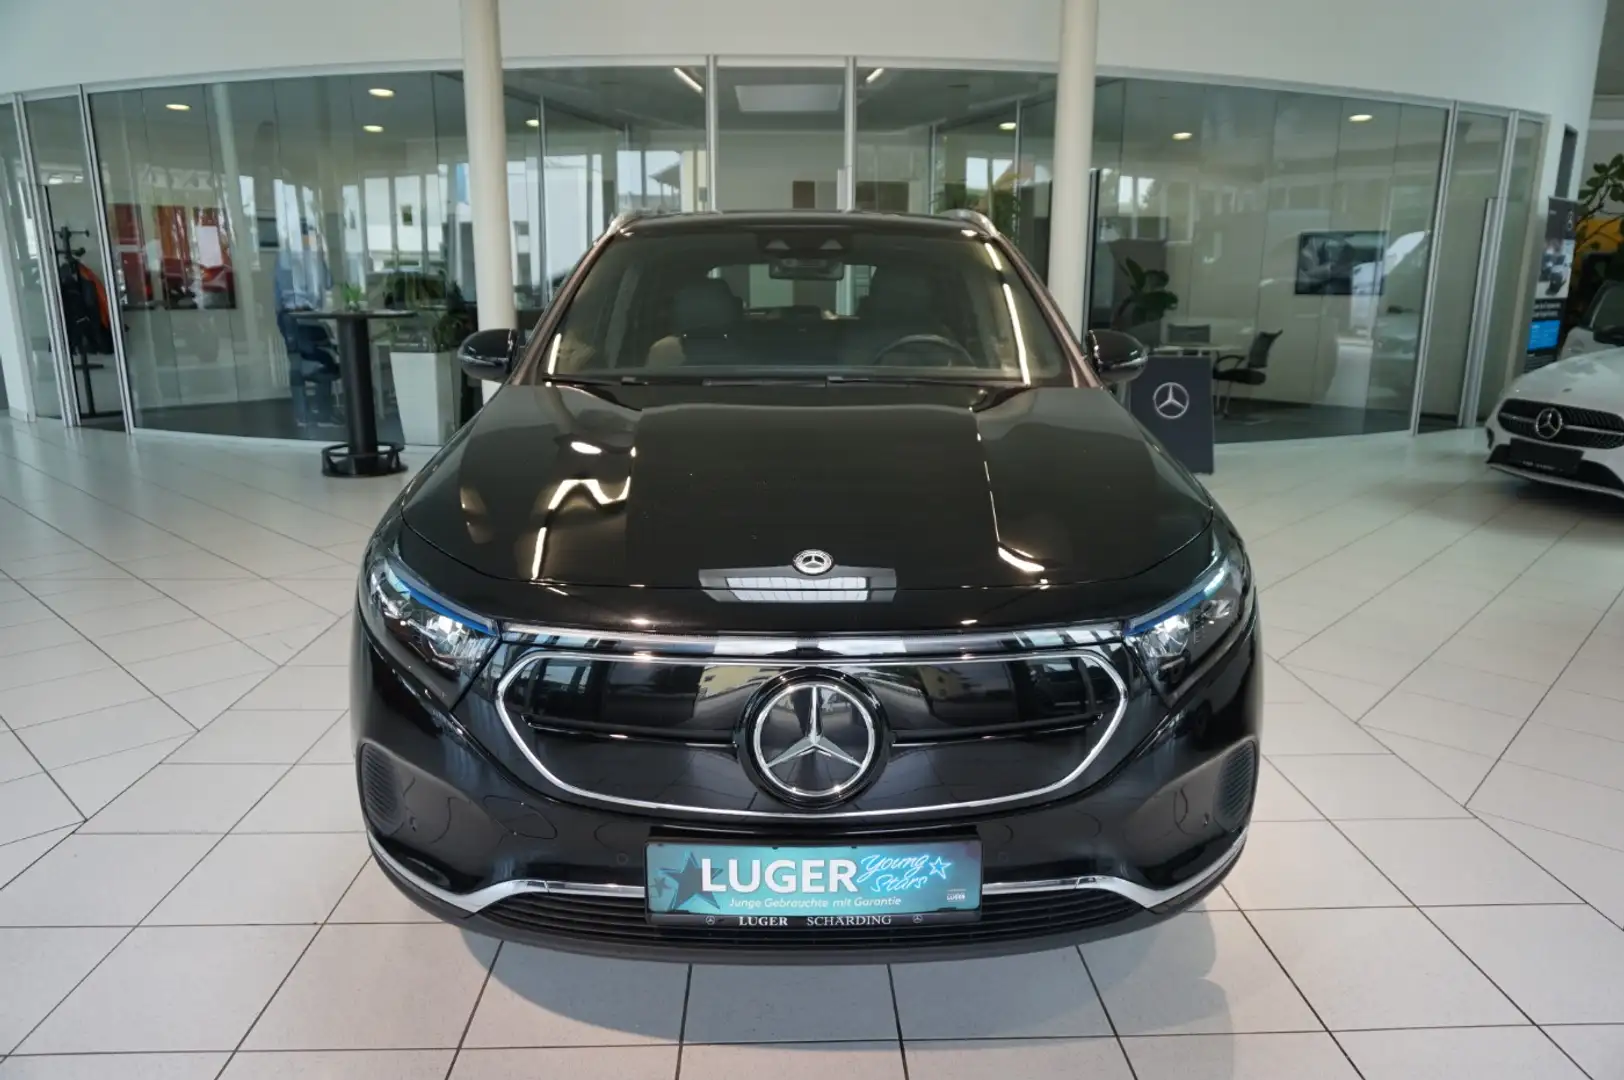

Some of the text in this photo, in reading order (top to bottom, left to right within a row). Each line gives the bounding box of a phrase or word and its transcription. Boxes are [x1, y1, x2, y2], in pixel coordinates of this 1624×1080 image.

[702, 859, 858, 893] LUGER
[857, 854, 930, 883] Young
[871, 874, 928, 892] Stars
[729, 896, 902, 909] Junge Gebrauchte mit Garantie
[739, 916, 788, 926] LUGER
